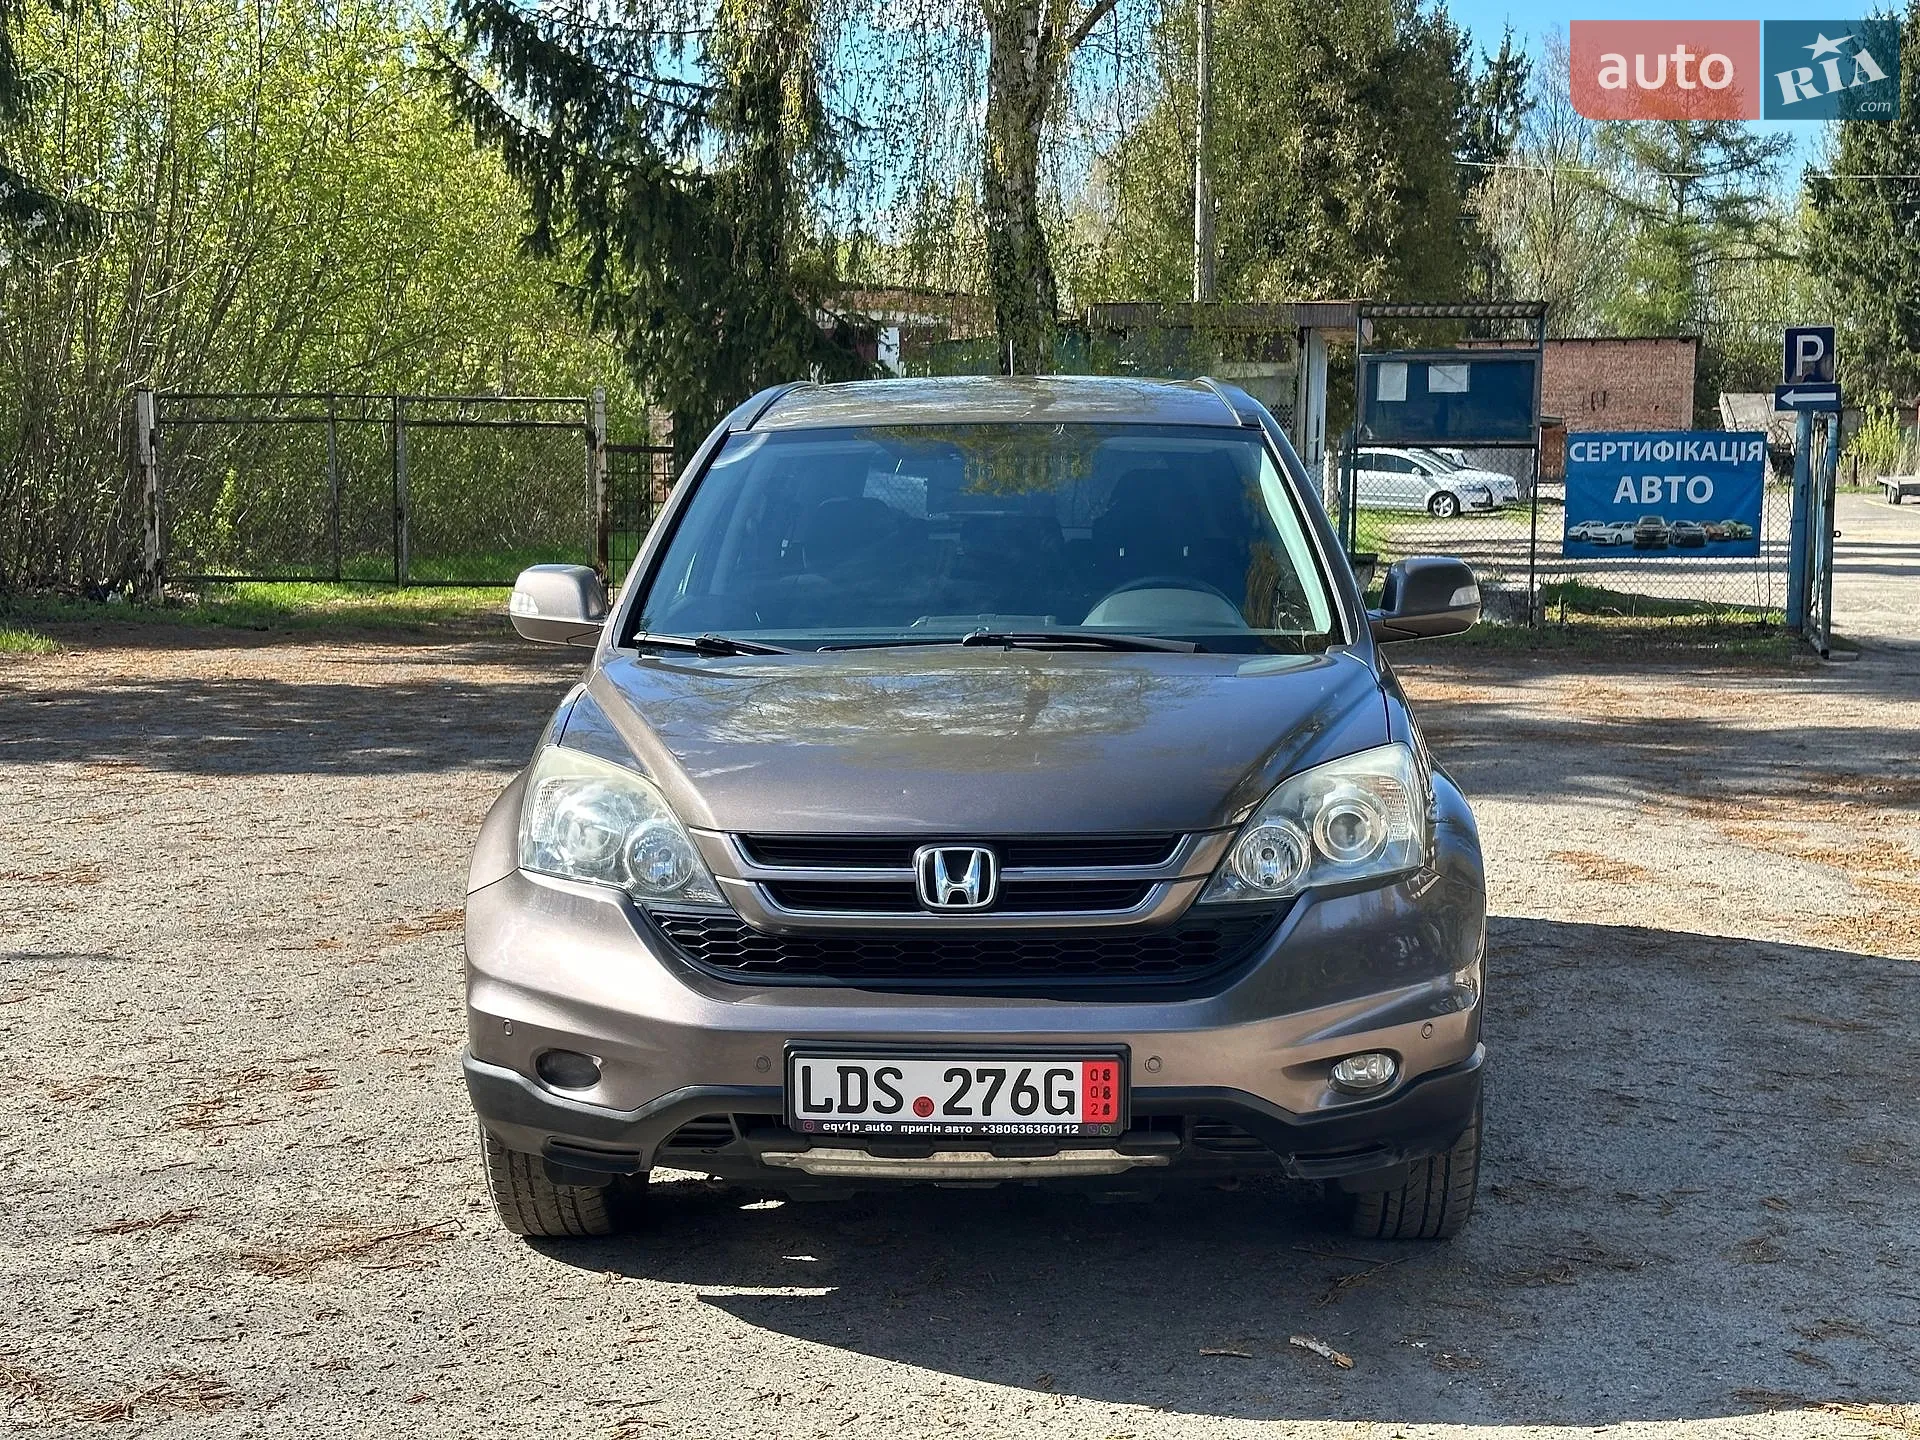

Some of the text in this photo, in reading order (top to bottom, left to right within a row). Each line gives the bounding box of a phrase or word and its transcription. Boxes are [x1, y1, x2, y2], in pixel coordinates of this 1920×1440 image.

[1796, 334, 1824, 377] P
[1569, 440, 1764, 466] СЕРТИФІКАЦІЯ
[1613, 475, 1714, 505] АВТО
[801, 1065, 1076, 1117] LDS 276G
[822, 1121, 1079, 1135] eqv1p_auto пригін авто +380636360112
